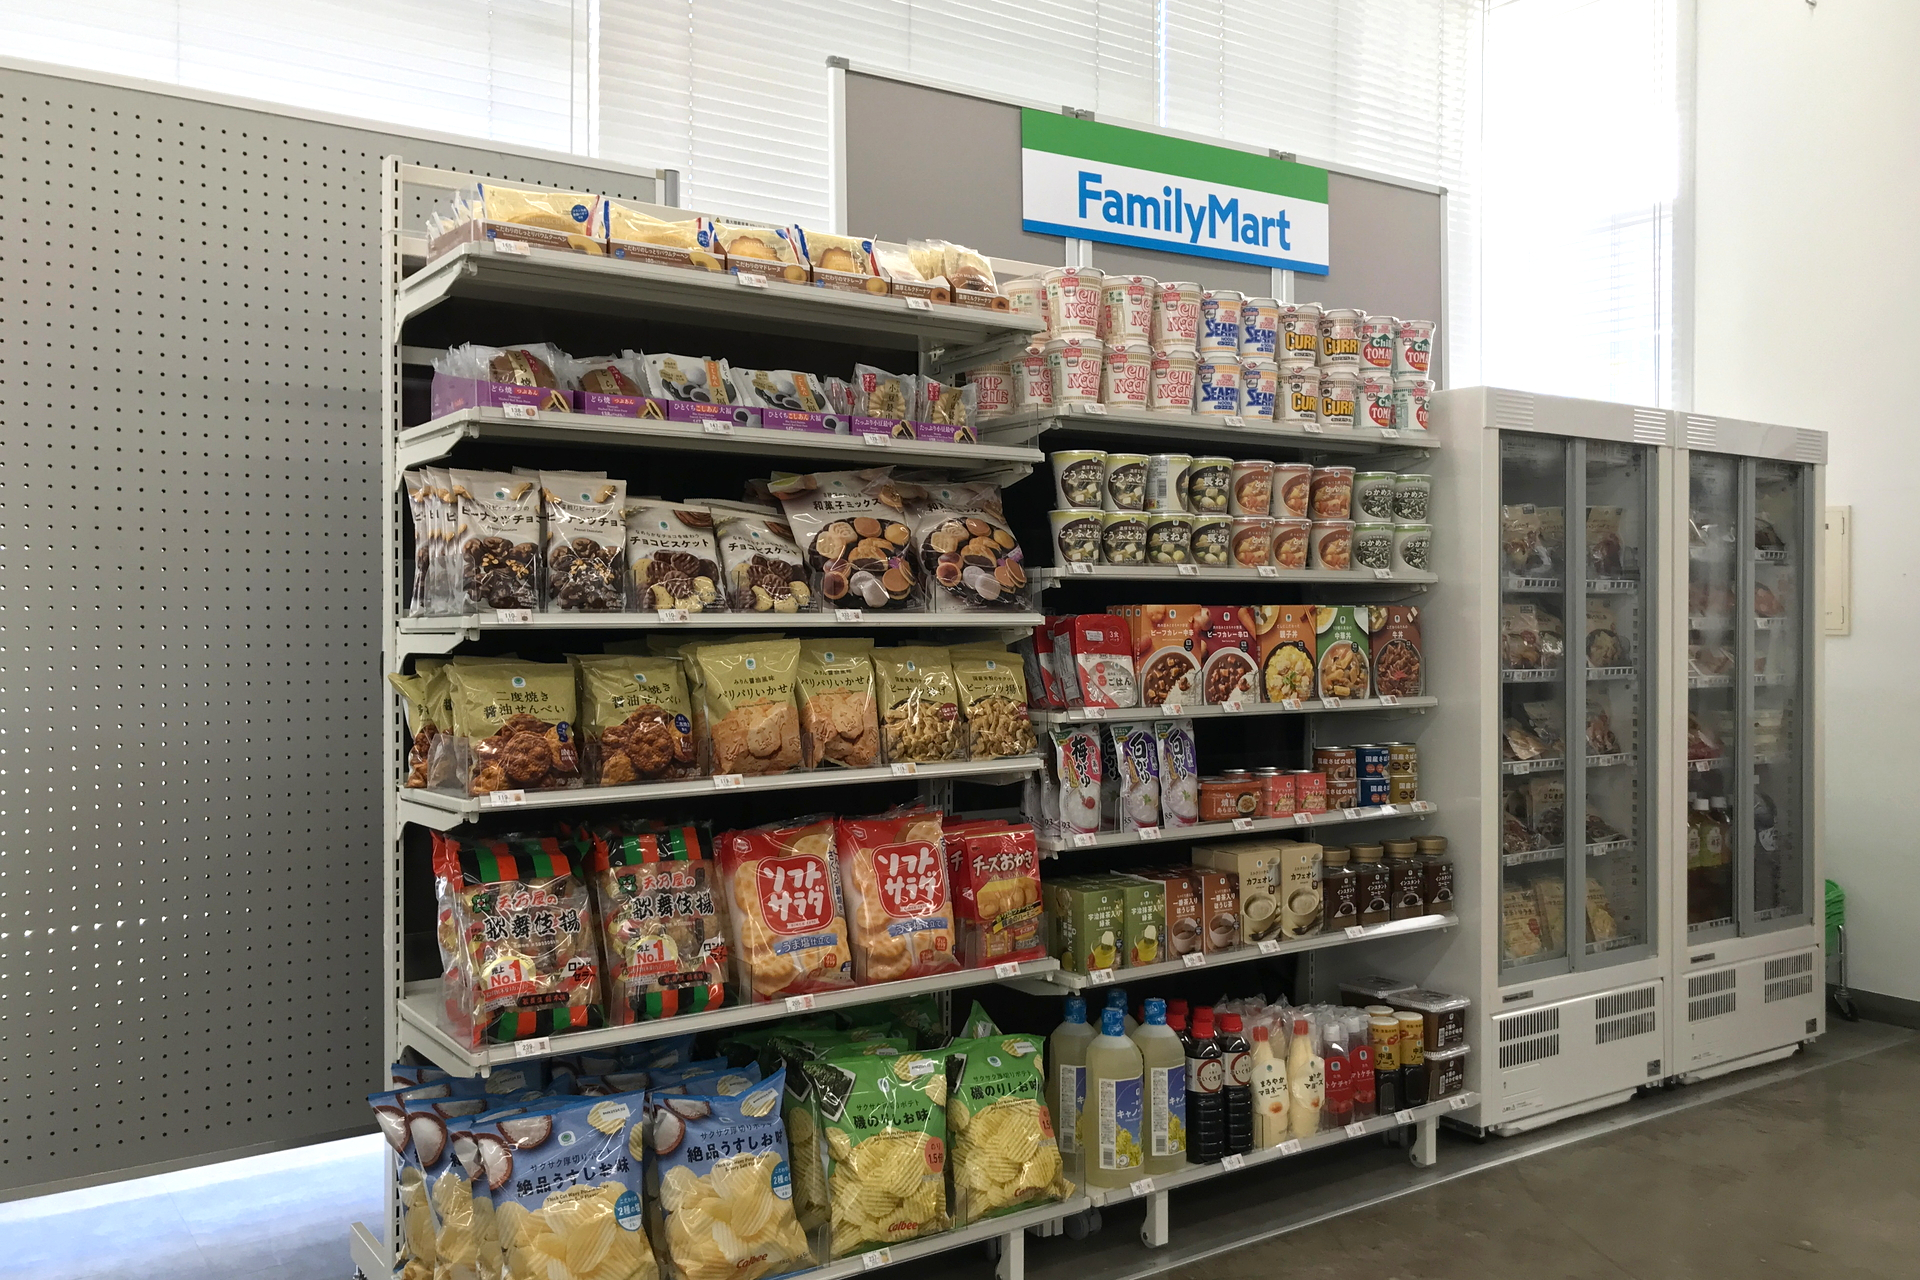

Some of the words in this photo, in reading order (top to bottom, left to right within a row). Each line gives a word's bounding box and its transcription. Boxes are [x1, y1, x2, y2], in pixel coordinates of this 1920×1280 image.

[1078, 170, 1291, 251] FamilyMart
[491, 385, 513, 395] どら焼
[516, 388, 538, 396] つぶあん
[590, 395, 611, 405] どら焼
[813, 498, 881, 511] 和菓子ミックス
[630, 535, 709, 548] チョコビスケット
[1150, 629, 1195, 637] ビーフカレー中辛
[734, 675, 775, 685] みりん醤油風味
[1108, 677, 1132, 687] ごはん
[496, 691, 549, 703] 二度焼き
[483, 704, 565, 718] 醤油せんべい
[1130, 730, 1152, 785] 白がゆ
[1168, 727, 1189, 782] 白がゆ
[1071, 734, 1092, 788] 梅がゆ
[877, 847, 935, 877] ソフト
[973, 850, 1033, 875] チーズおかき
[643, 872, 695, 890] 天乃屋の
[763, 861, 822, 892] ソフト
[1246, 876, 1273, 886] カフェオレ
[1291, 871, 1317, 881] カフェオレ
[1400, 878, 1420, 886] インスタント
[1435, 874, 1452, 882] インスタント
[884, 871, 937, 905] サラダ
[1367, 883, 1387, 891] インスタント
[497, 891, 558, 909] 天乃屋の
[1173, 897, 1198, 906] 一番茶入り
[1210, 893, 1235, 901] 一番茶入り
[632, 892, 714, 920] 歌舞伎揚
[767, 885, 825, 922] サラダ
[1131, 904, 1164, 915] 宇治抹茶入り
[1176, 905, 1195, 914] ほうじ茶
[1214, 901, 1233, 909] ほうじ茶
[1088, 909, 1122, 921] 宇治抹茶入り
[1141, 913, 1153, 921] 緑茶
[484, 909, 581, 940] 歌舞伎揚
[1099, 918, 1111, 927] 緑茶
[781, 934, 831, 950] うま塩仕立て
[1378, 1052, 1392, 1060] 中濃
[1260, 1077, 1285, 1087] まろやか
[687, 1129, 783, 1163] 絶品うすしお味
[516, 1156, 630, 1197] 絶品うすしお味
[888, 1220, 918, 1232] Calbee
[736, 1252, 768, 1269] Calbee
